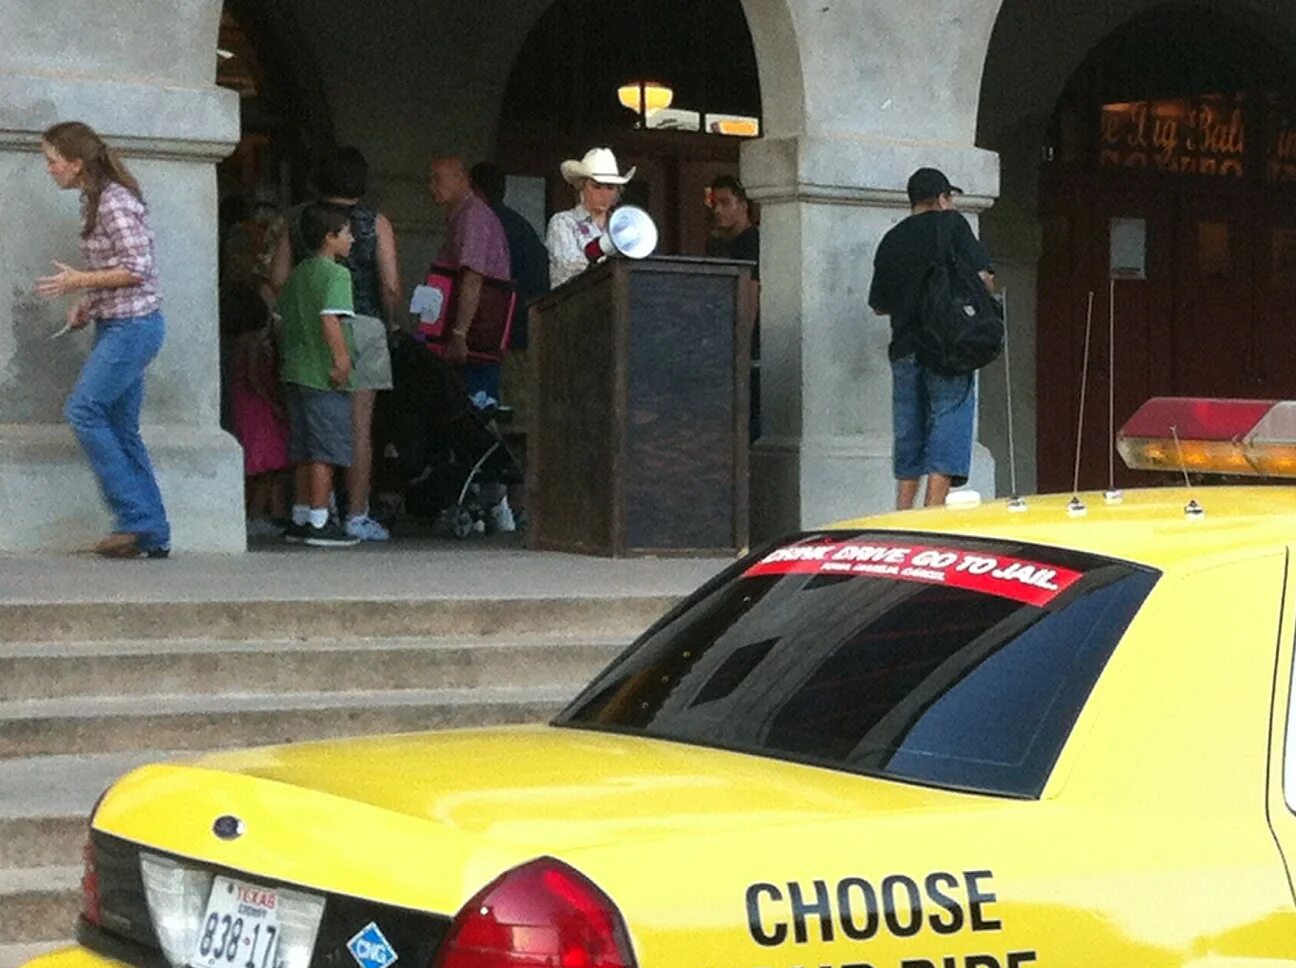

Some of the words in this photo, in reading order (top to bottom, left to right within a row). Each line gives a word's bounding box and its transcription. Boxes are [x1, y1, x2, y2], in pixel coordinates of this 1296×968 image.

[911, 550, 957, 568] GO
[956, 555, 997, 574] TO
[238, 887, 276, 910] TEXAS
[745, 870, 1002, 947] CHOOSE
